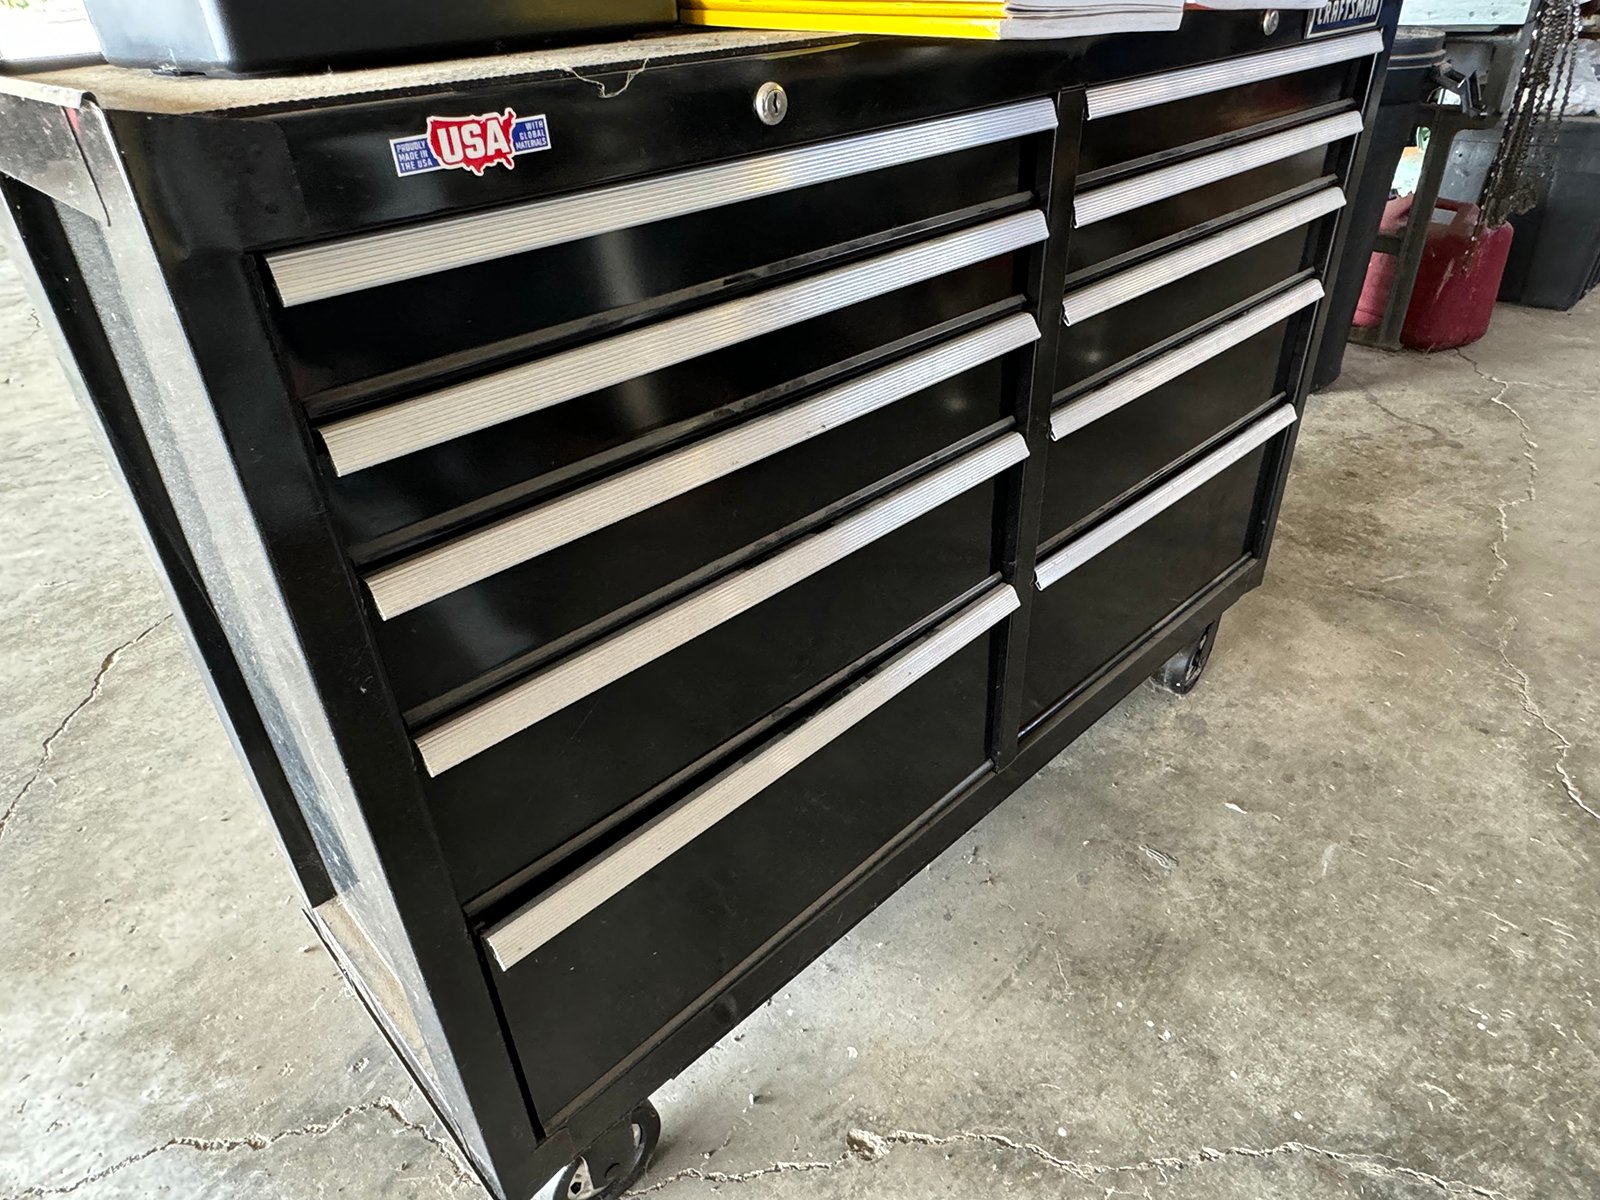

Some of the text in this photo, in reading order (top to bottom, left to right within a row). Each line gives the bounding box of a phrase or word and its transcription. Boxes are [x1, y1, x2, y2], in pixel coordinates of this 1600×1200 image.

[1316, 0, 1378, 25] CRAFTSMAN
[525, 120, 543, 131] WITH
[437, 119, 510, 163] USA
[519, 129, 545, 140] GLOBAL
[396, 140, 426, 153] PROUDLY
[515, 137, 547, 150] MATERIALS
[398, 149, 429, 162] MADE IN
[400, 158, 433, 171] THE USA
